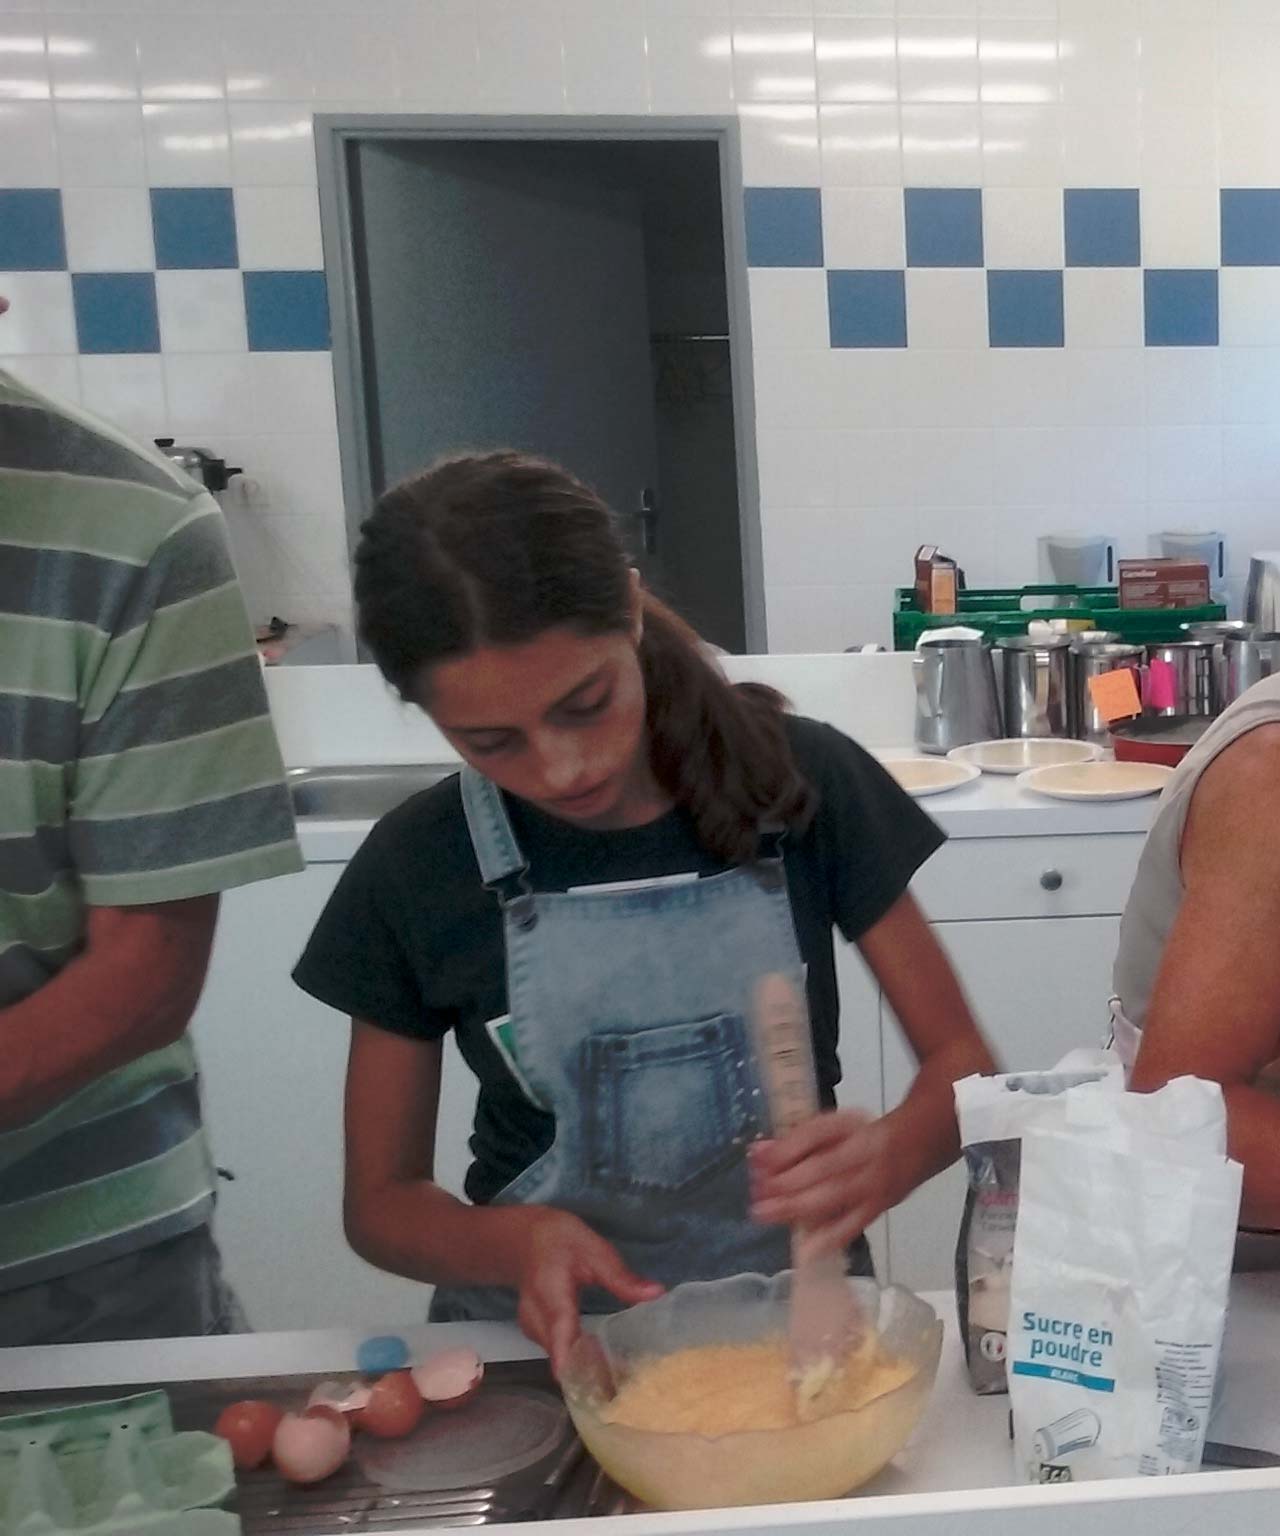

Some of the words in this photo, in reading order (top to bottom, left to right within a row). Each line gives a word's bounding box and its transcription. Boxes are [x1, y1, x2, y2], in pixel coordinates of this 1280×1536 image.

[1022, 1311, 1083, 1340] Sucre
[1088, 1326, 1113, 1347] en
[1029, 1338, 1103, 1367] poudre
